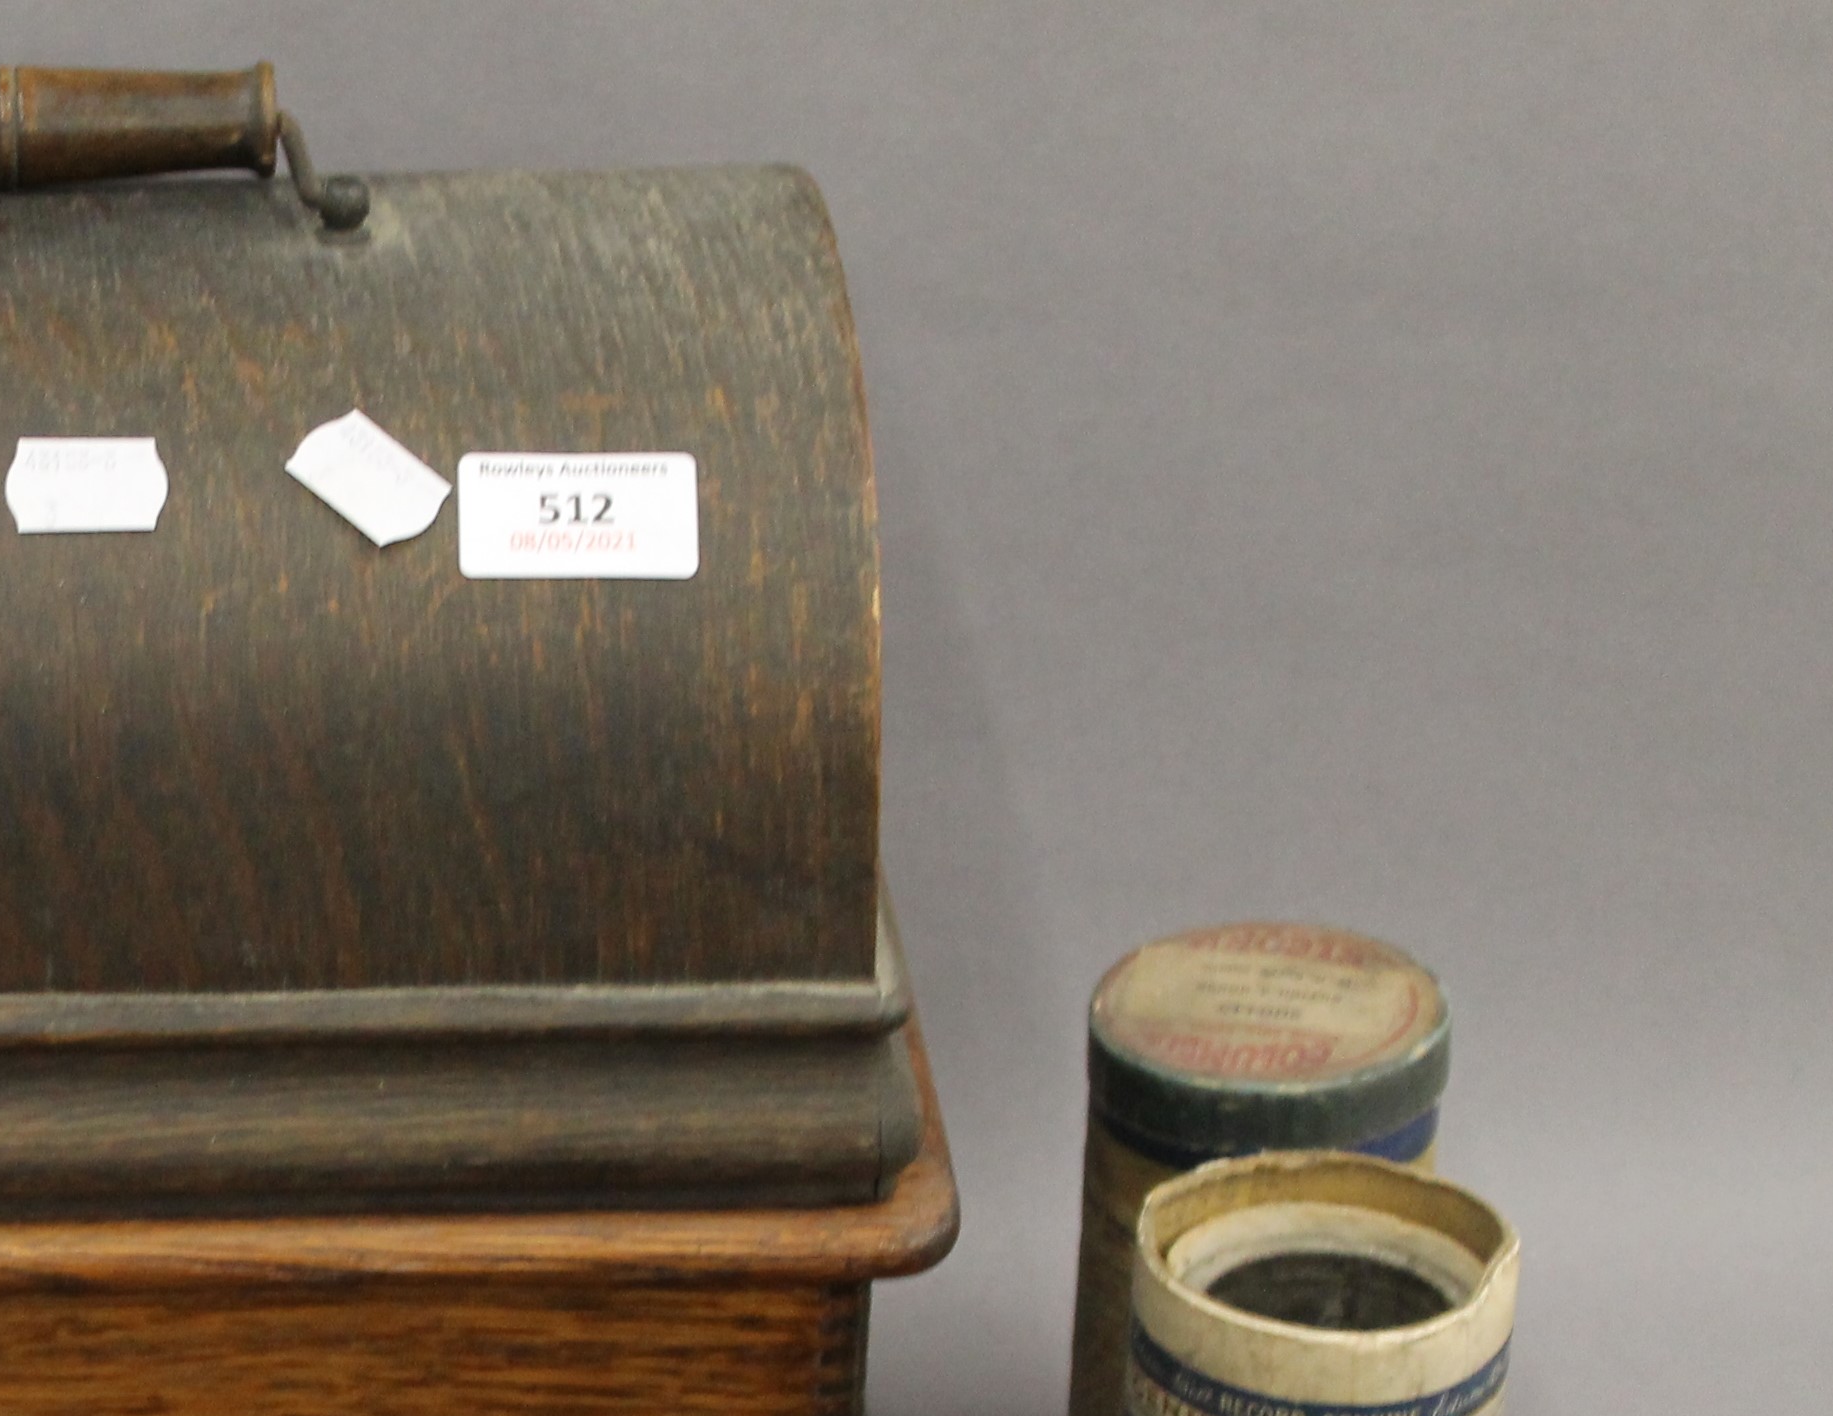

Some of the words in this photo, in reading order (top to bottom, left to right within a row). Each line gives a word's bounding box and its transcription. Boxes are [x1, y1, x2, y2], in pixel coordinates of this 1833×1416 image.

[559, 457, 668, 478] Auctioneers
[539, 491, 615, 525] 512
[509, 530, 636, 553] 08/05/2021
